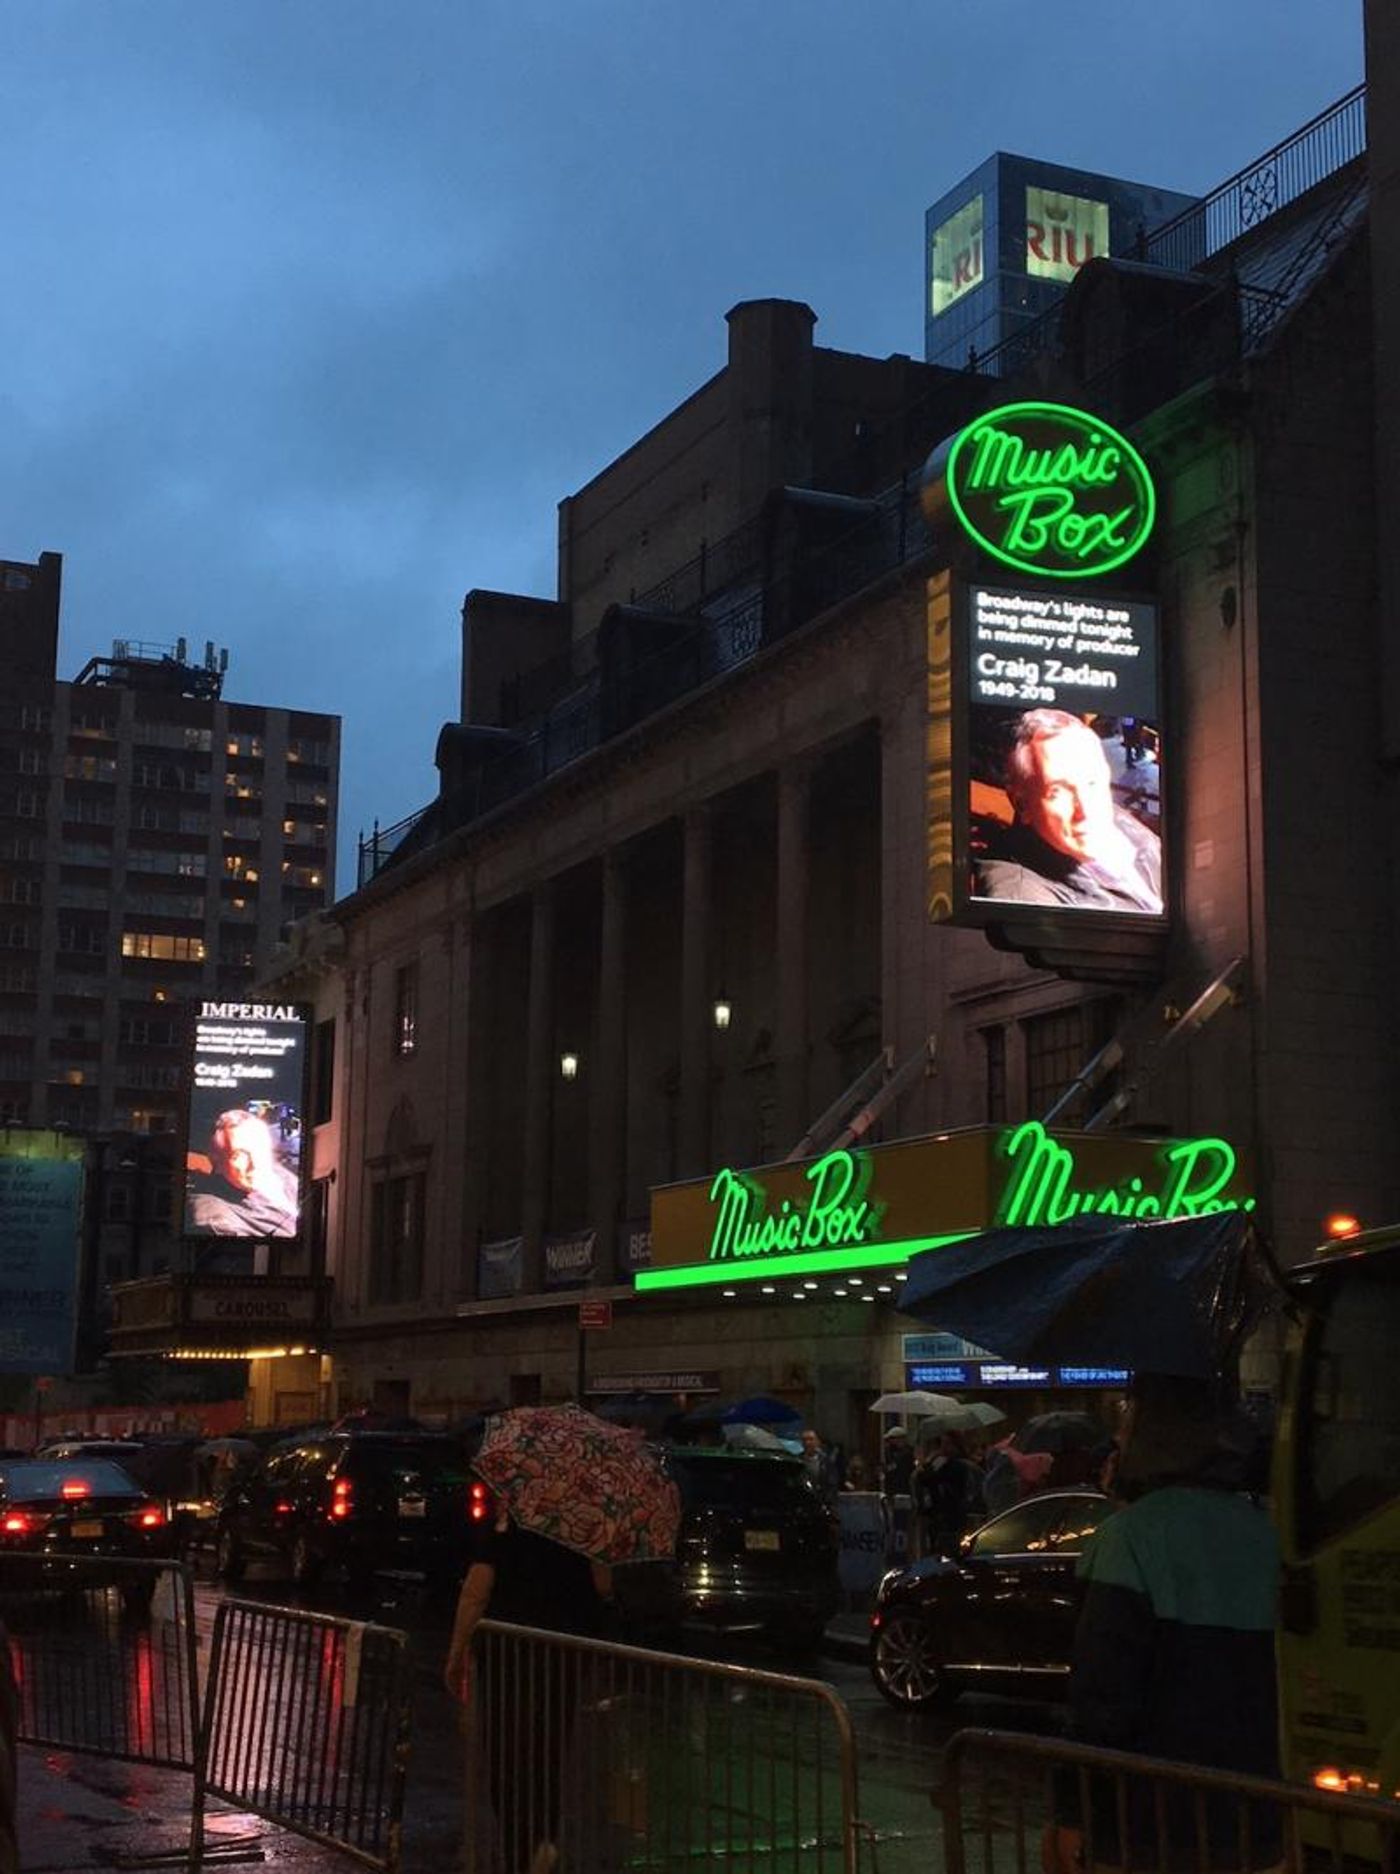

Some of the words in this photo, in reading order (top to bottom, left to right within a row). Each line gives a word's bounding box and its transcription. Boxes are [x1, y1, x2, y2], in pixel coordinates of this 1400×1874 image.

[973, 424, 1120, 488] Music
[999, 486, 1135, 557] Box
[977, 591, 1061, 615] Broadway's
[1063, 602, 1103, 621] lights
[1106, 609, 1129, 622] are
[978, 609, 1018, 629] being
[1021, 614, 1077, 633] dimmed
[1080, 622, 1133, 641] tonight
[978, 626, 992, 639] in
[994, 630, 1054, 650] memory
[1057, 635, 1074, 648] of
[1077, 639, 1140, 656] producer
[978, 653, 1039, 685] Craig
[1044, 660, 1117, 688] Zadan
[201, 1002, 300, 1021] IMPERIAL
[708, 1167, 804, 1260] Music
[806, 1150, 870, 1249] Box
